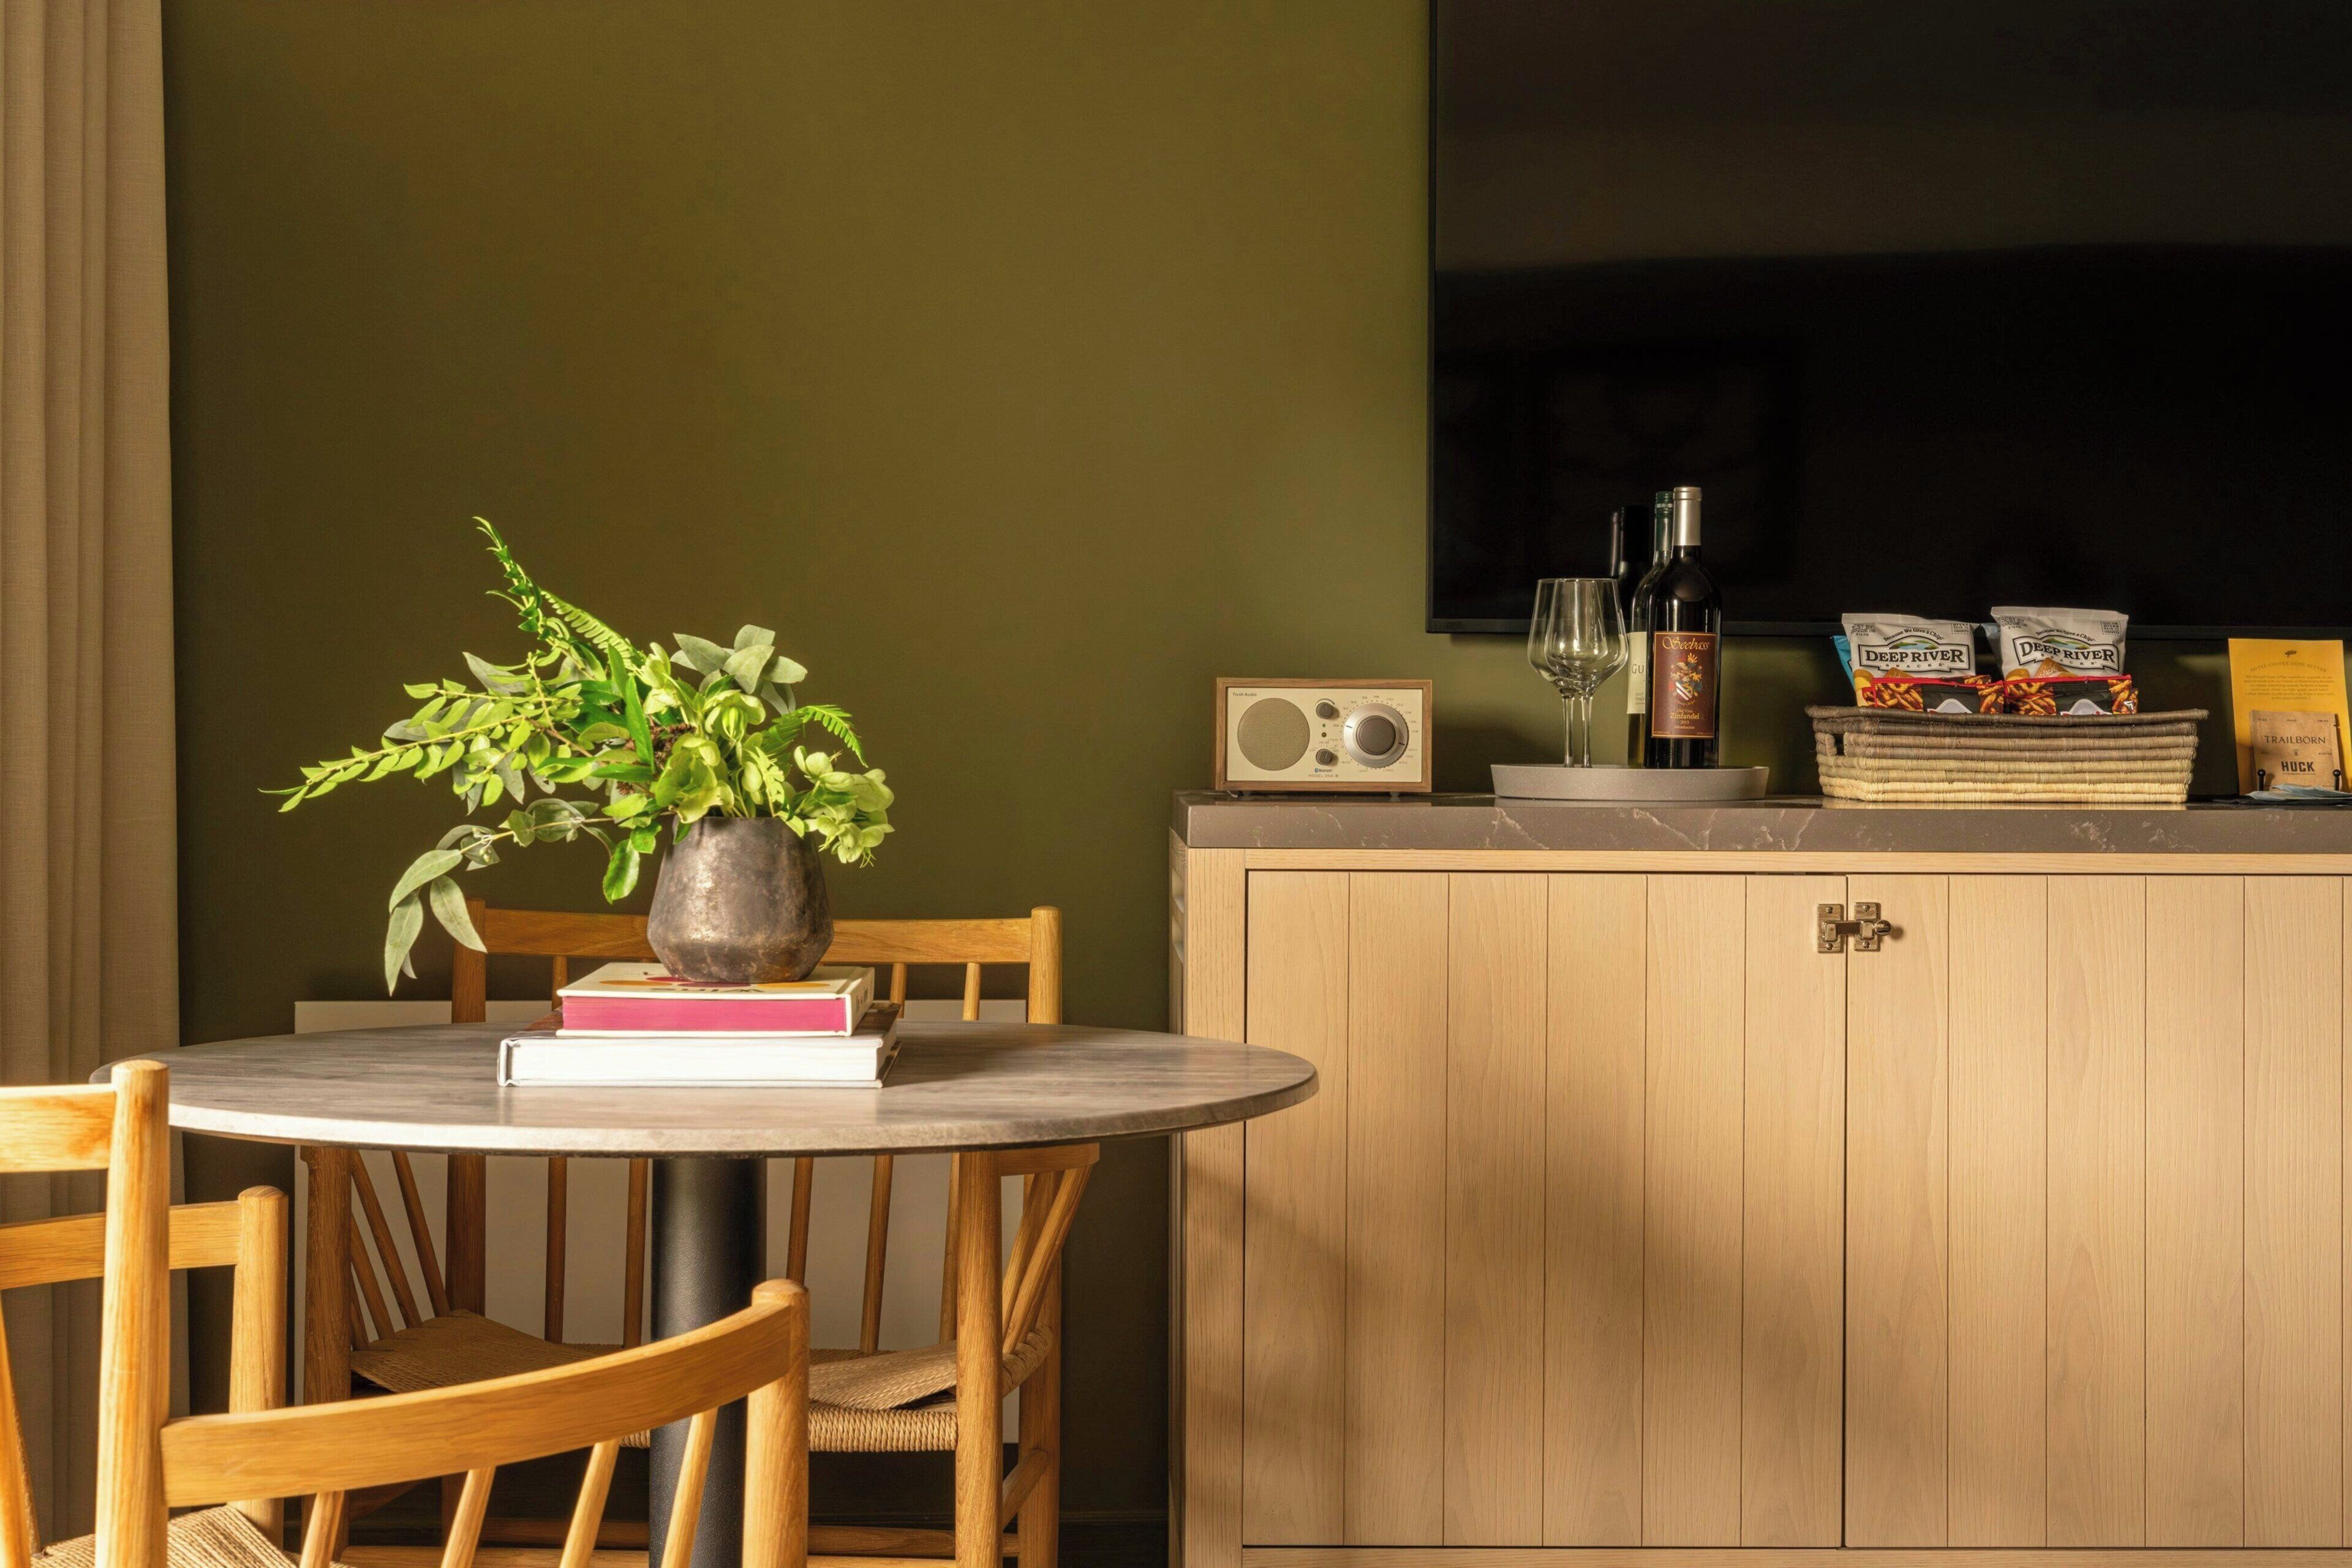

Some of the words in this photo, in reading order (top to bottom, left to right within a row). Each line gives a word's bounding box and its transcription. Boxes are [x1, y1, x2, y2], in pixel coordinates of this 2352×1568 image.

[1883, 631, 1904, 641] Because
[1662, 636, 1709, 650] Seebass
[1864, 650, 1909, 662] DEEP
[1910, 649, 1964, 663] RIVER
[2019, 641, 2061, 657] DEEP
[2062, 649, 2116, 663] RIVER
[1632, 663, 1644, 674] GU
[2264, 735, 2326, 744] TRAILBORN
[2281, 761, 2315, 772] HUCK
